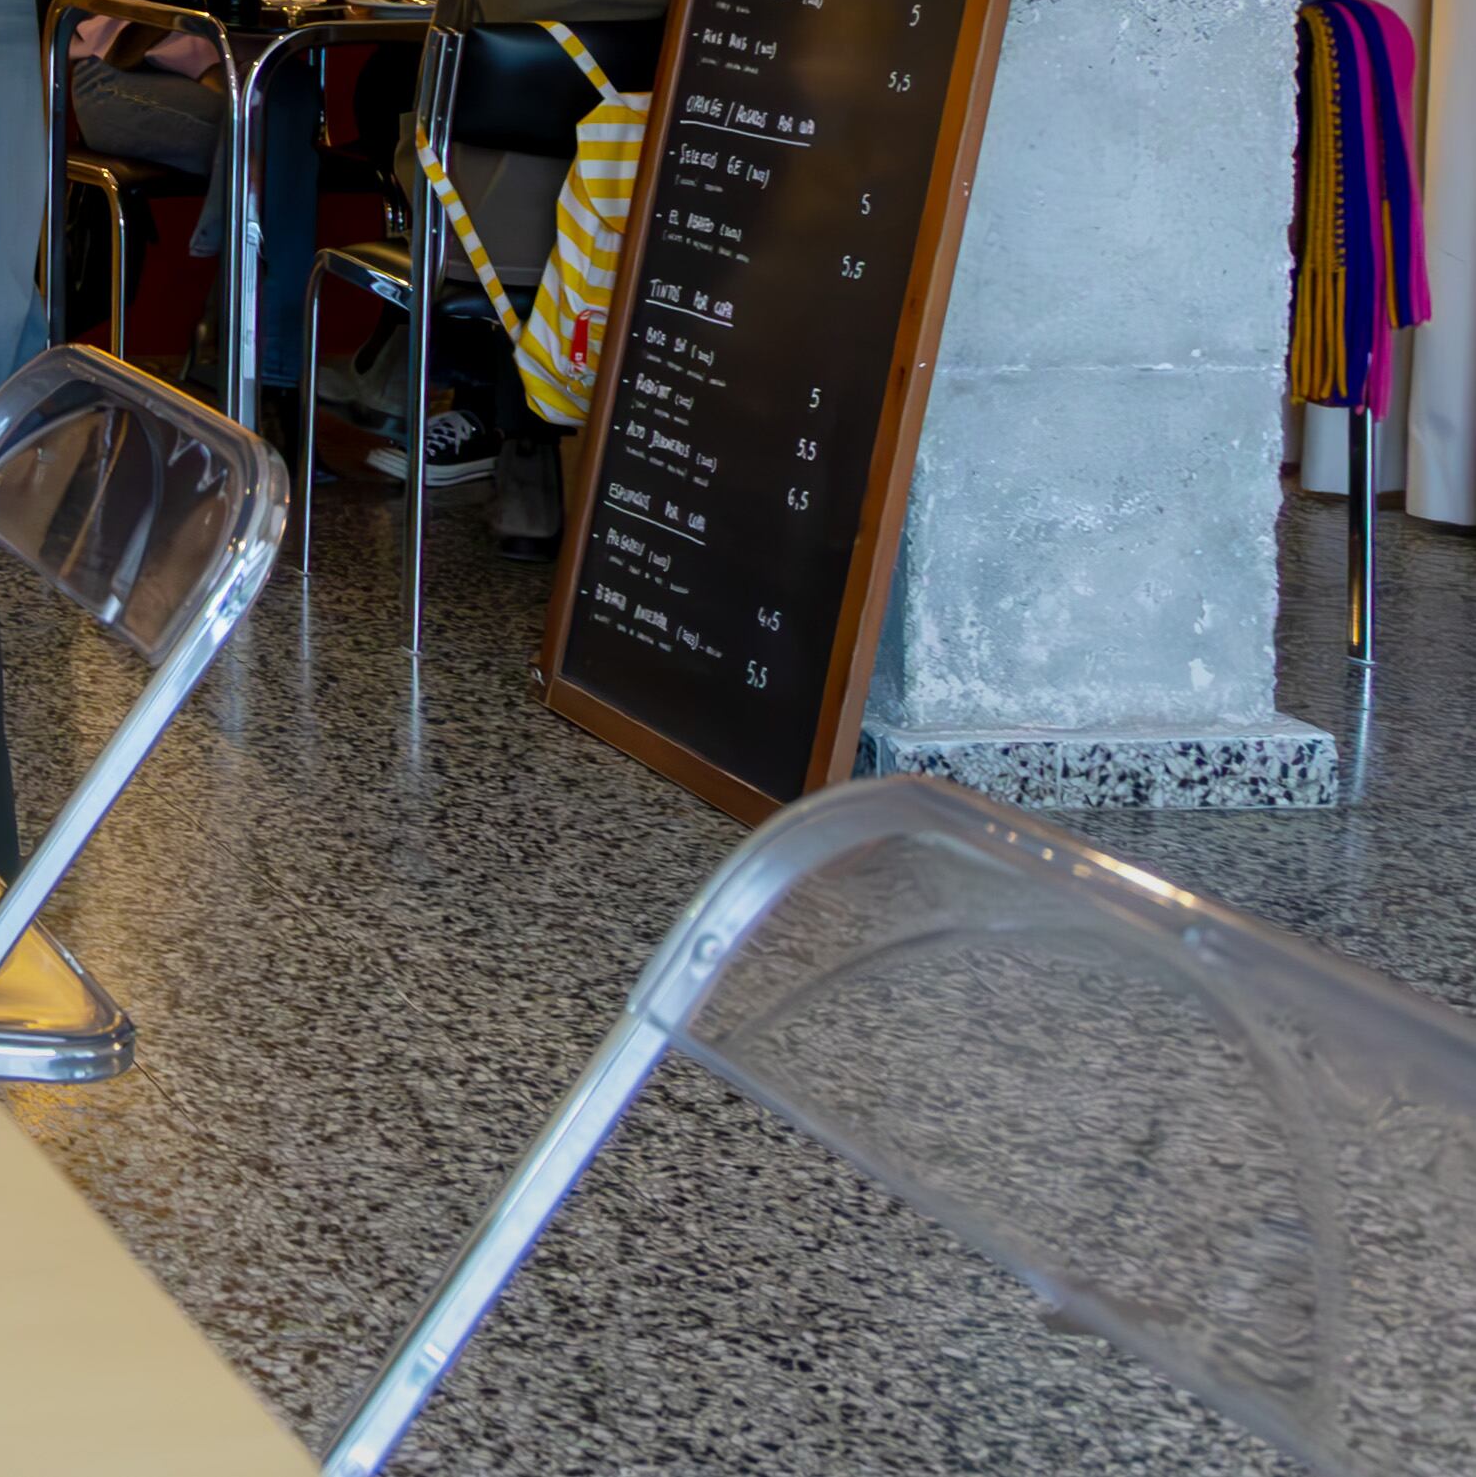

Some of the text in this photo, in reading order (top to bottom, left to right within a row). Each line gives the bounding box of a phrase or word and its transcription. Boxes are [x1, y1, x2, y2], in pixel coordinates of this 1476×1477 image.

[908, 3, 922, 27] 5
[887, 71, 912, 93] 5,5
[860, 193, 871, 216] 5
[841, 255, 866, 280] 5,5
[650, 278, 683, 303] TINTOS
[693, 290, 709, 312] POR
[808, 387, 822, 409] 5
[796, 437, 818, 462] 5,5
[787, 486, 810, 512] 6,5
[757, 606, 783, 632] 4,5
[746, 660, 768, 689] 5,5
